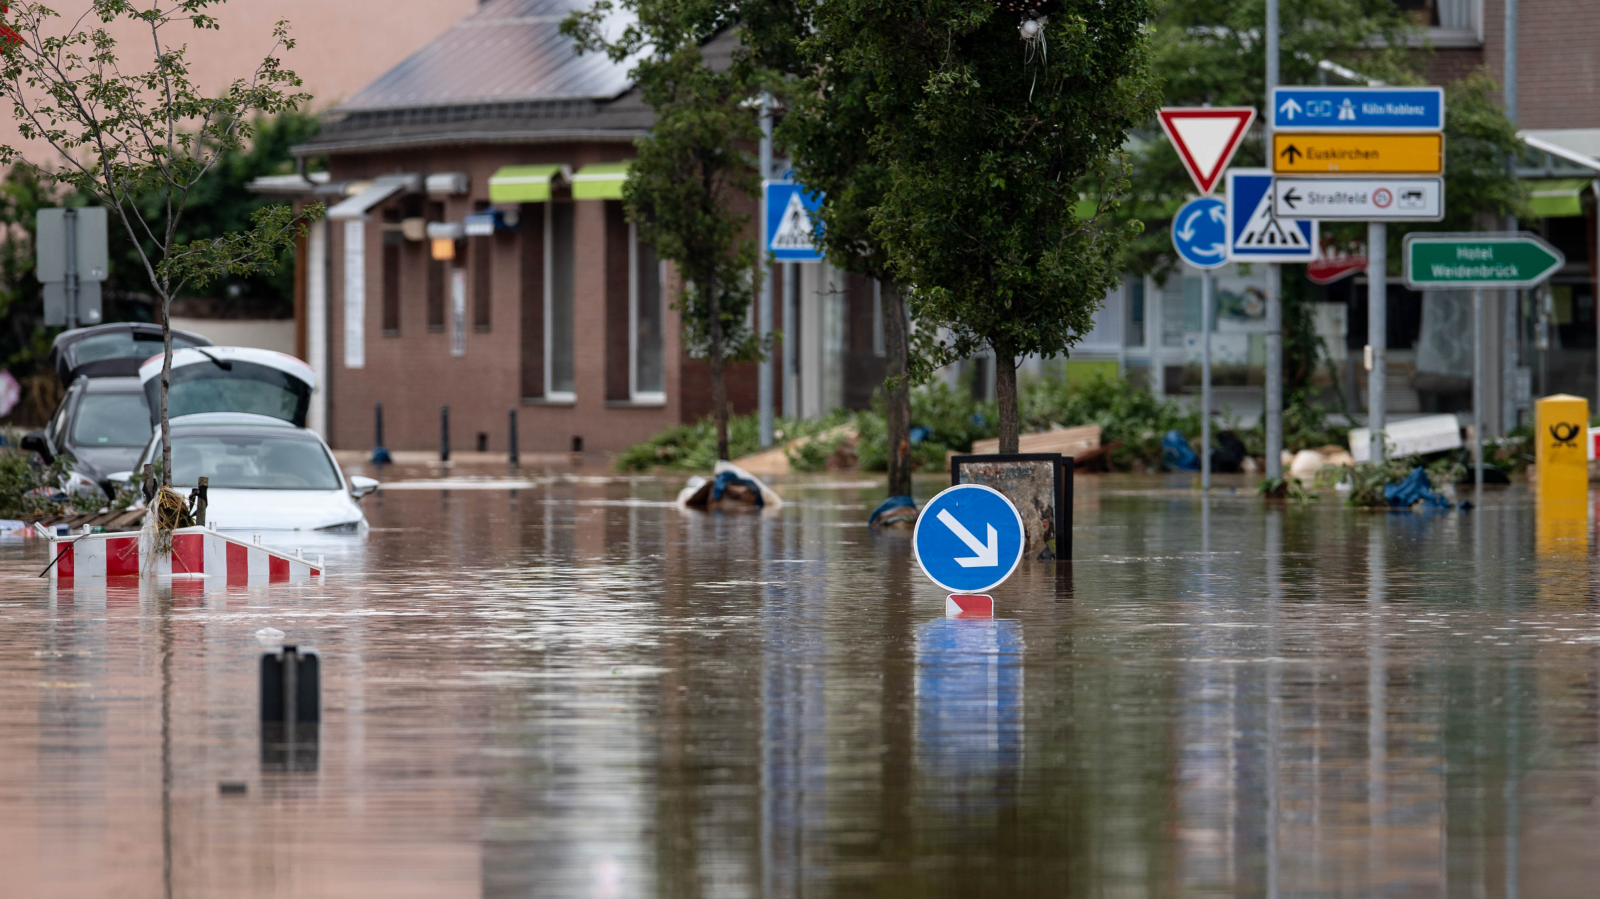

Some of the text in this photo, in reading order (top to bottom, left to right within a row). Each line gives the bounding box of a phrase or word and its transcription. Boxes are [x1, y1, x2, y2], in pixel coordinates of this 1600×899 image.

[1306, 147, 1380, 160] Euskirchen
[1307, 191, 1367, 204] Straßfeld
[1456, 245, 1493, 260] Hotel
[1431, 263, 1519, 278] Weidenbrück
